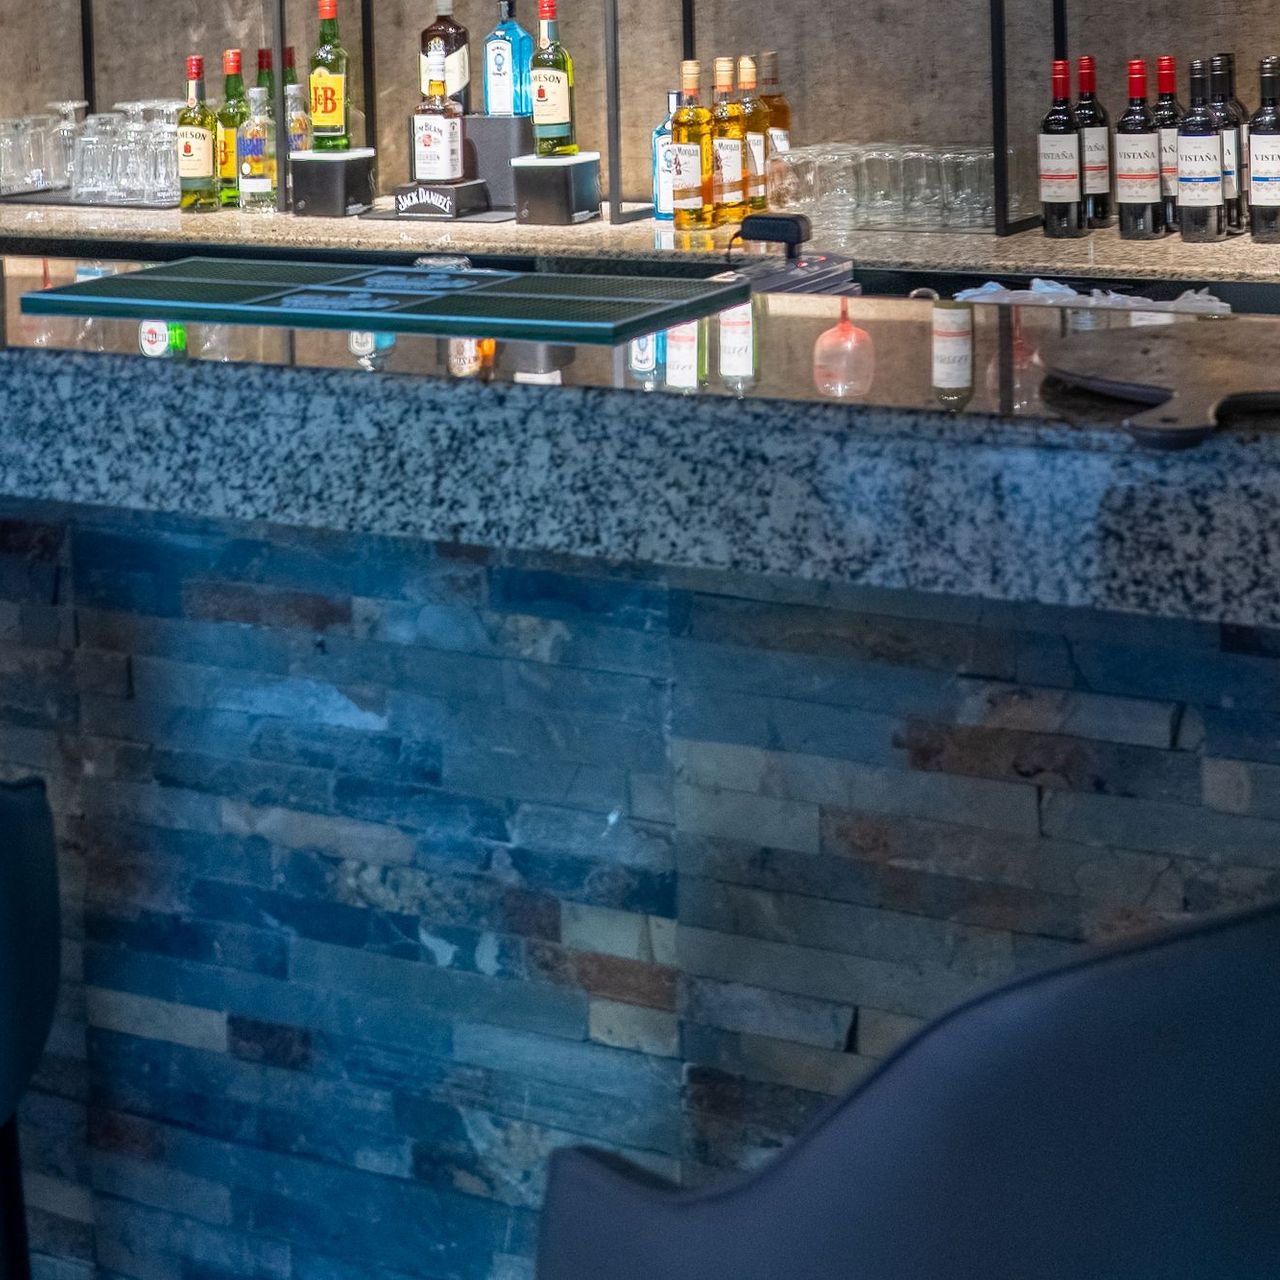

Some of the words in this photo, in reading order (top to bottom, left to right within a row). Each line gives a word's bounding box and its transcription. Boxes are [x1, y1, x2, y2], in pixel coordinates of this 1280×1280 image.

[1119, 150, 1156, 159] VISTAÑA
[1179, 153, 1218, 162] VISTAÑA
[397, 189, 420, 211] JACK
[418, 188, 453, 213] DANIEL'S
